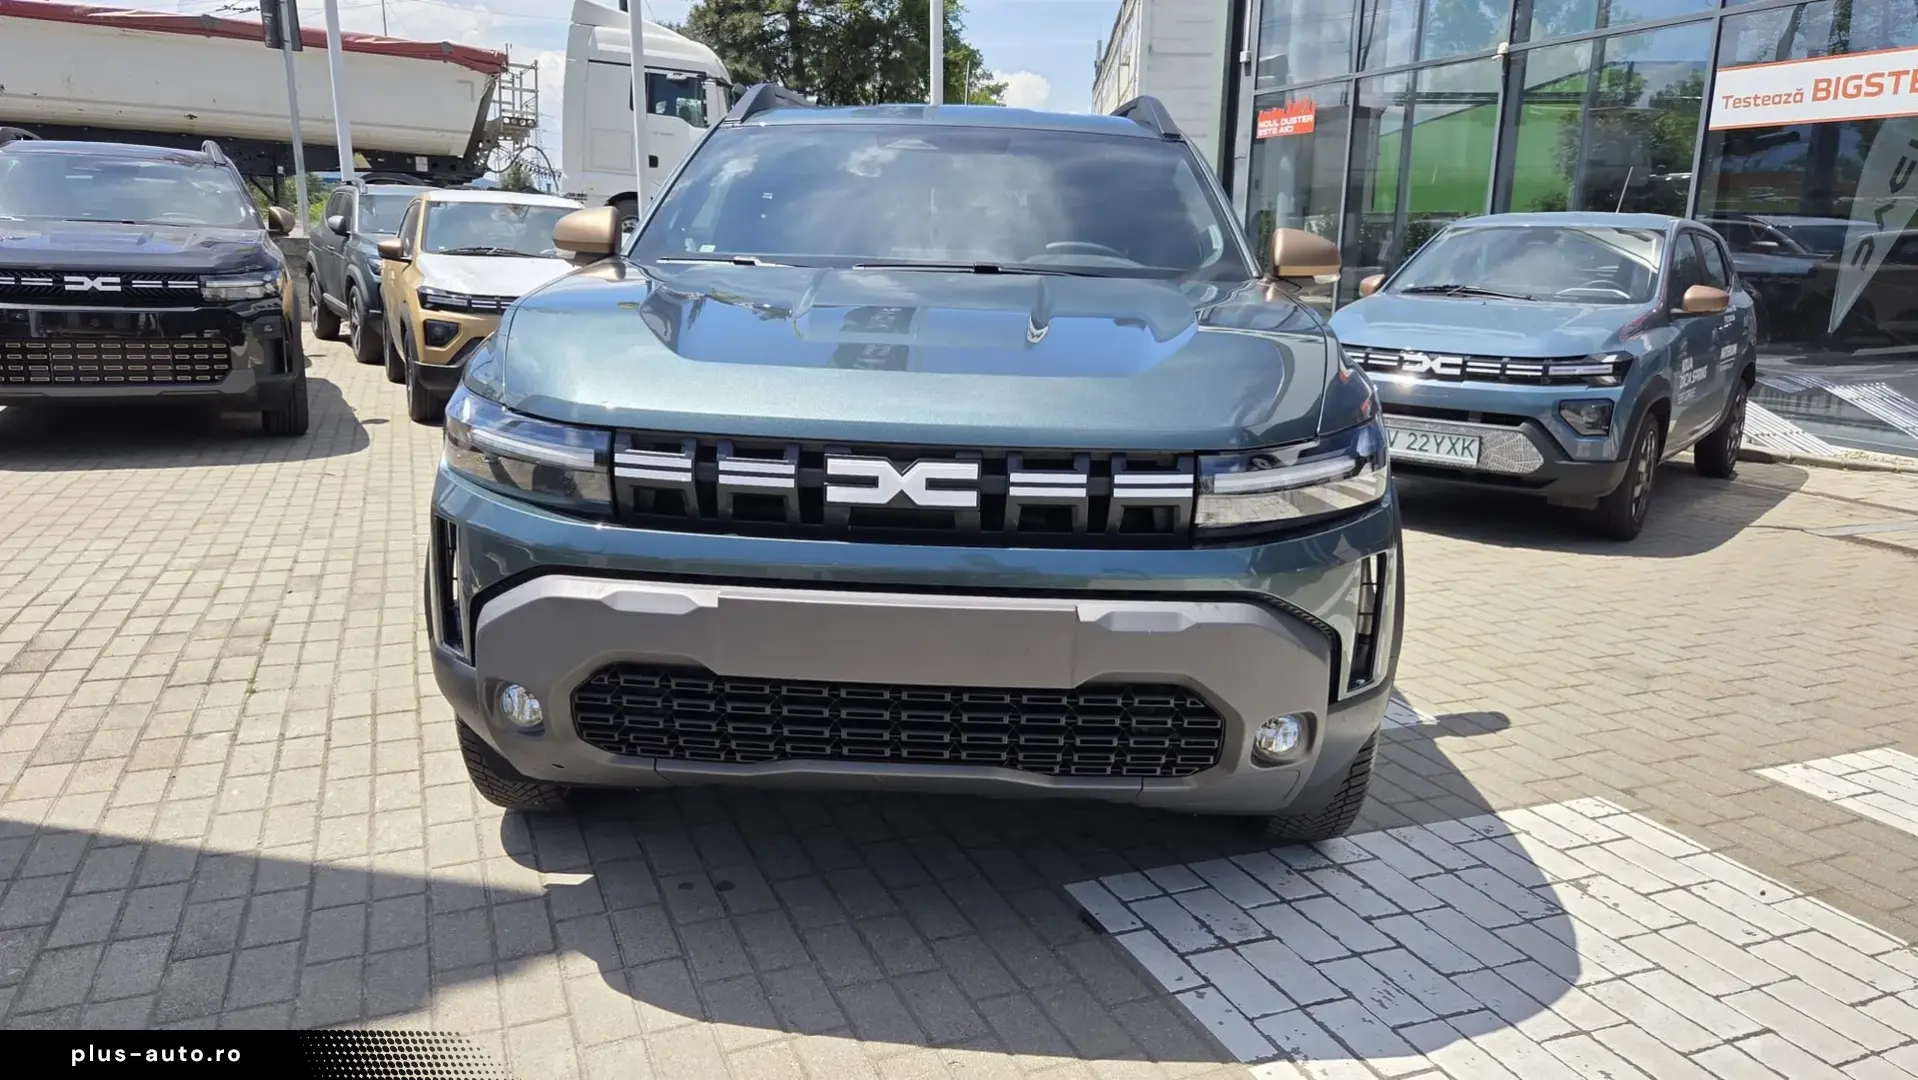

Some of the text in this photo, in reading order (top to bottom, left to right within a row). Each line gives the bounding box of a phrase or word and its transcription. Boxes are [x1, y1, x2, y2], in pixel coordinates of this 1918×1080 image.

[1722, 88, 1804, 110] Testează
[1280, 114, 1314, 126] DUSTER
[1257, 127, 1278, 137] ESTE
[1407, 432, 1475, 458] 22YXK
